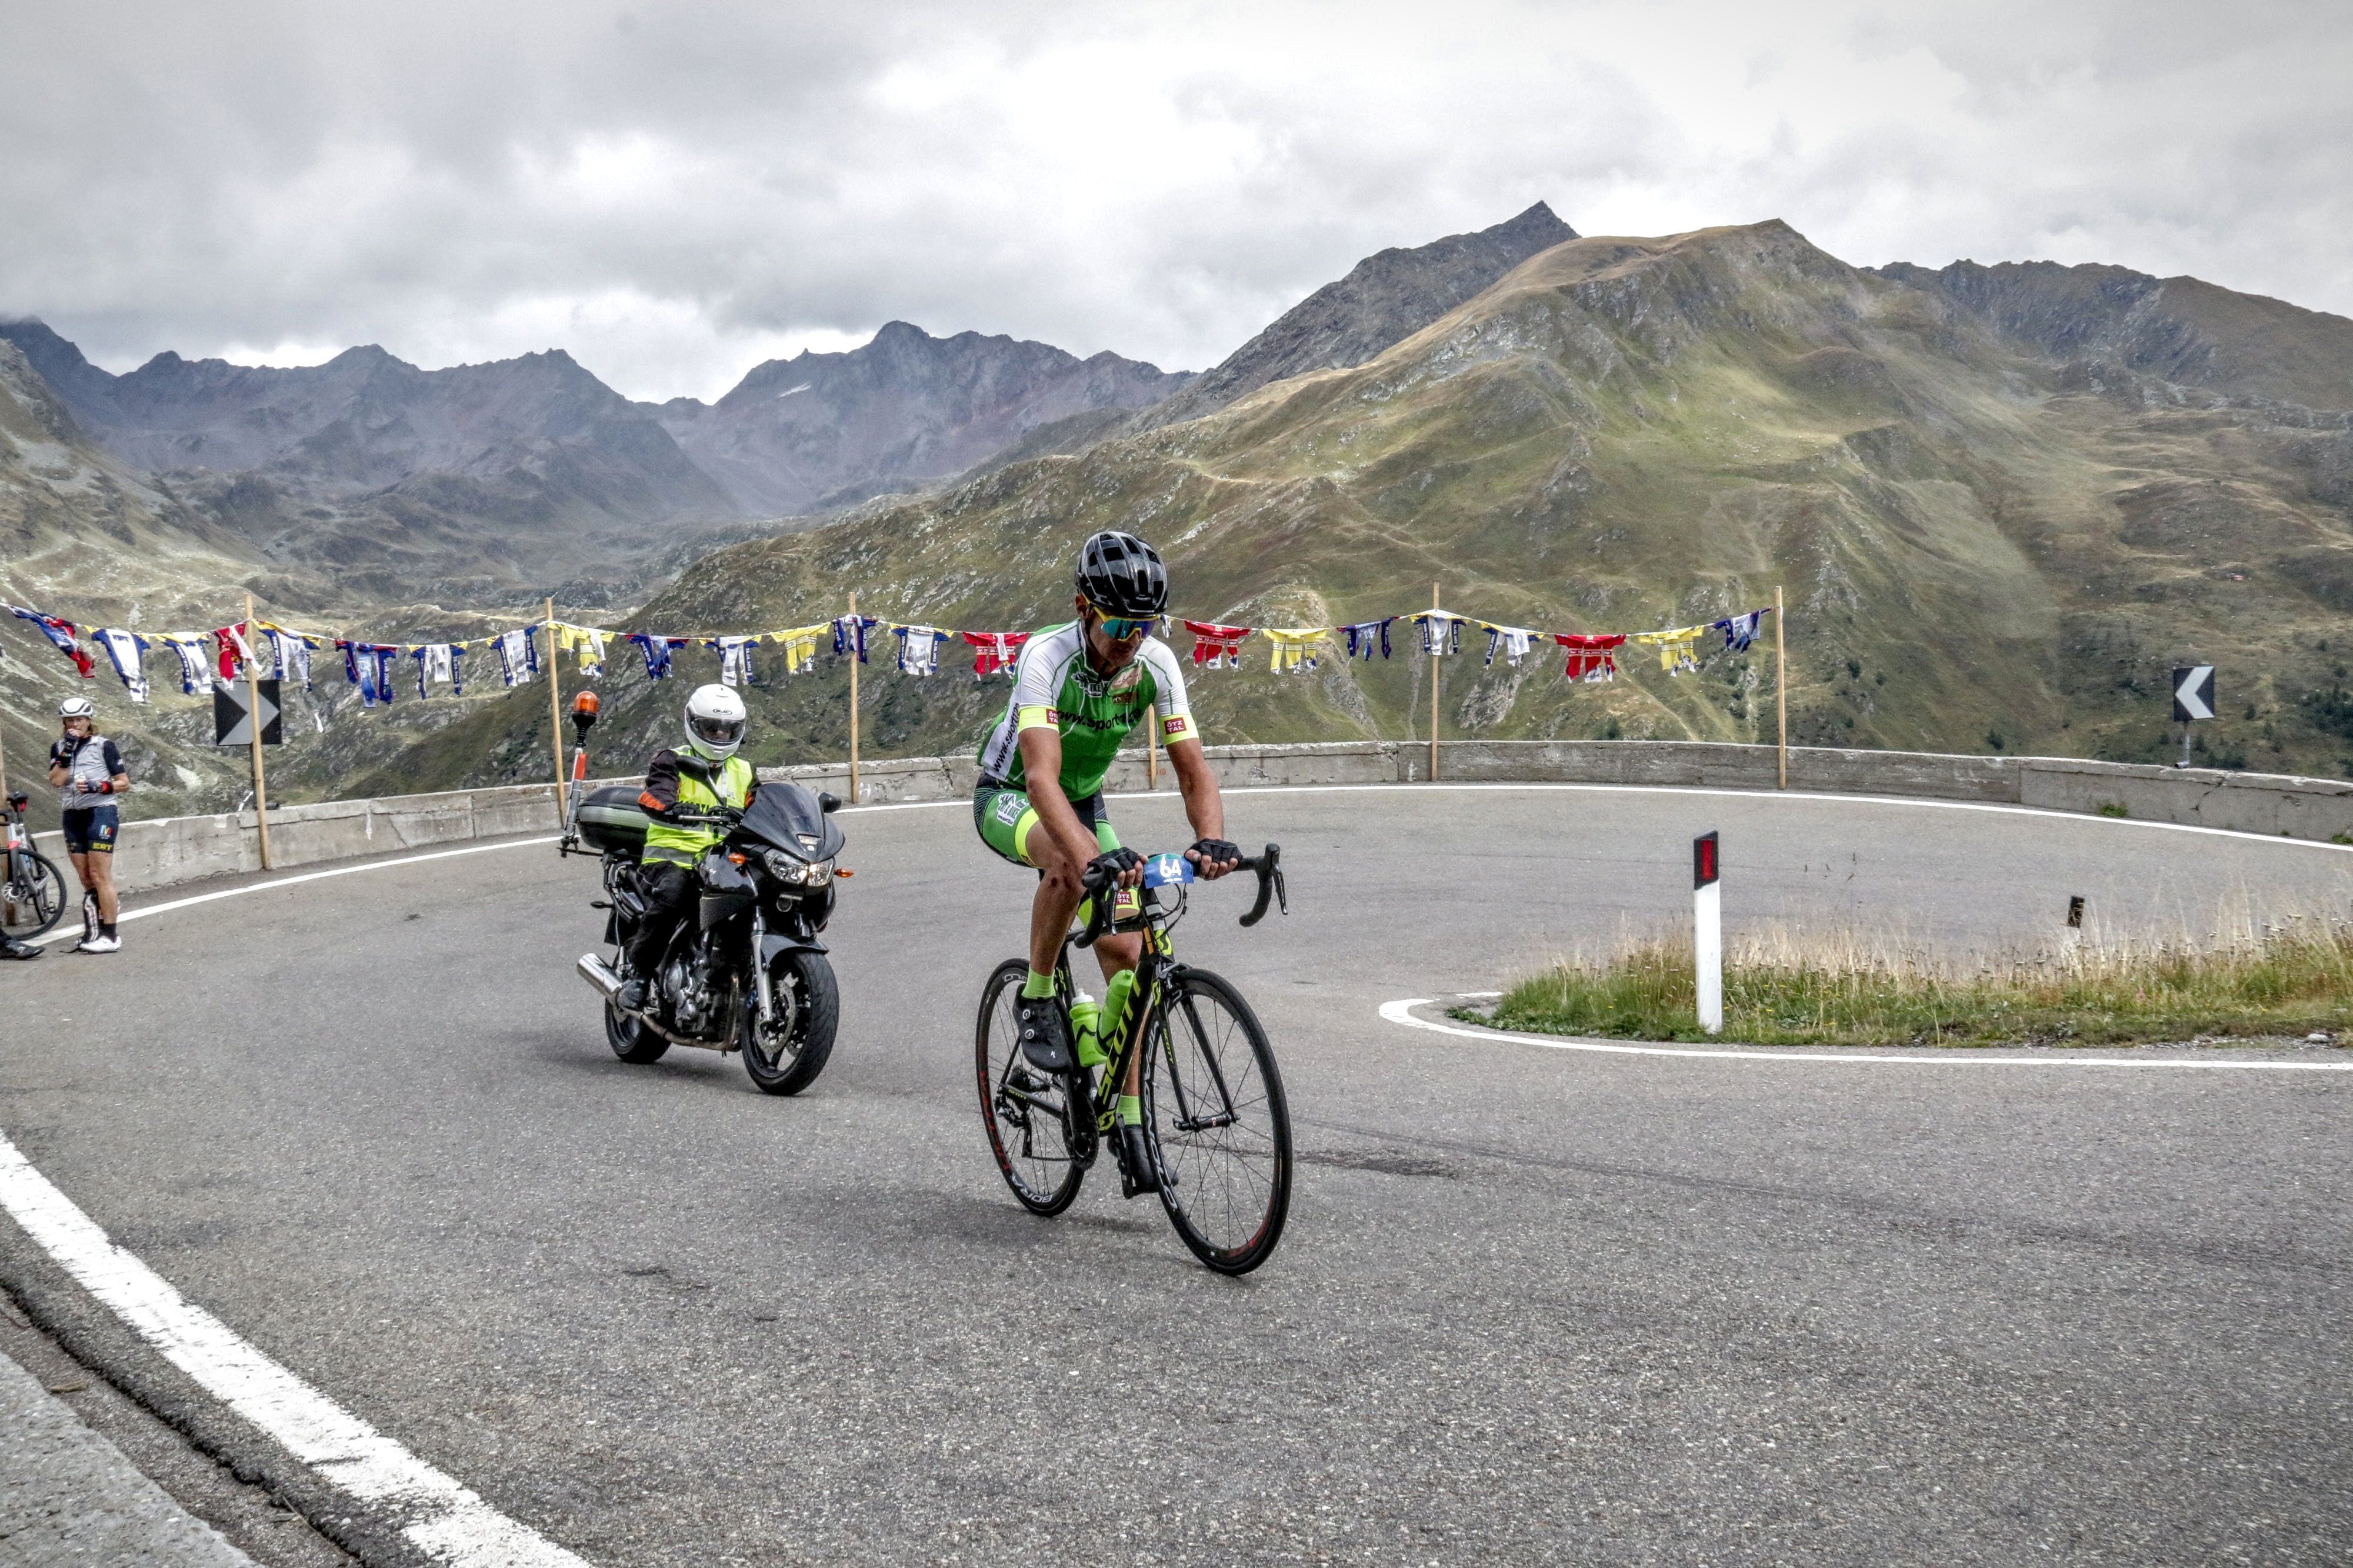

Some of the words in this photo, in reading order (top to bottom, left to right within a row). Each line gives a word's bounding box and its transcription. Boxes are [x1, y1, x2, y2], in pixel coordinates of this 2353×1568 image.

[1159, 854, 1181, 878] 64
[1163, 1028, 1174, 1064] SCOTT
[1012, 1176, 1053, 1203] BORA
